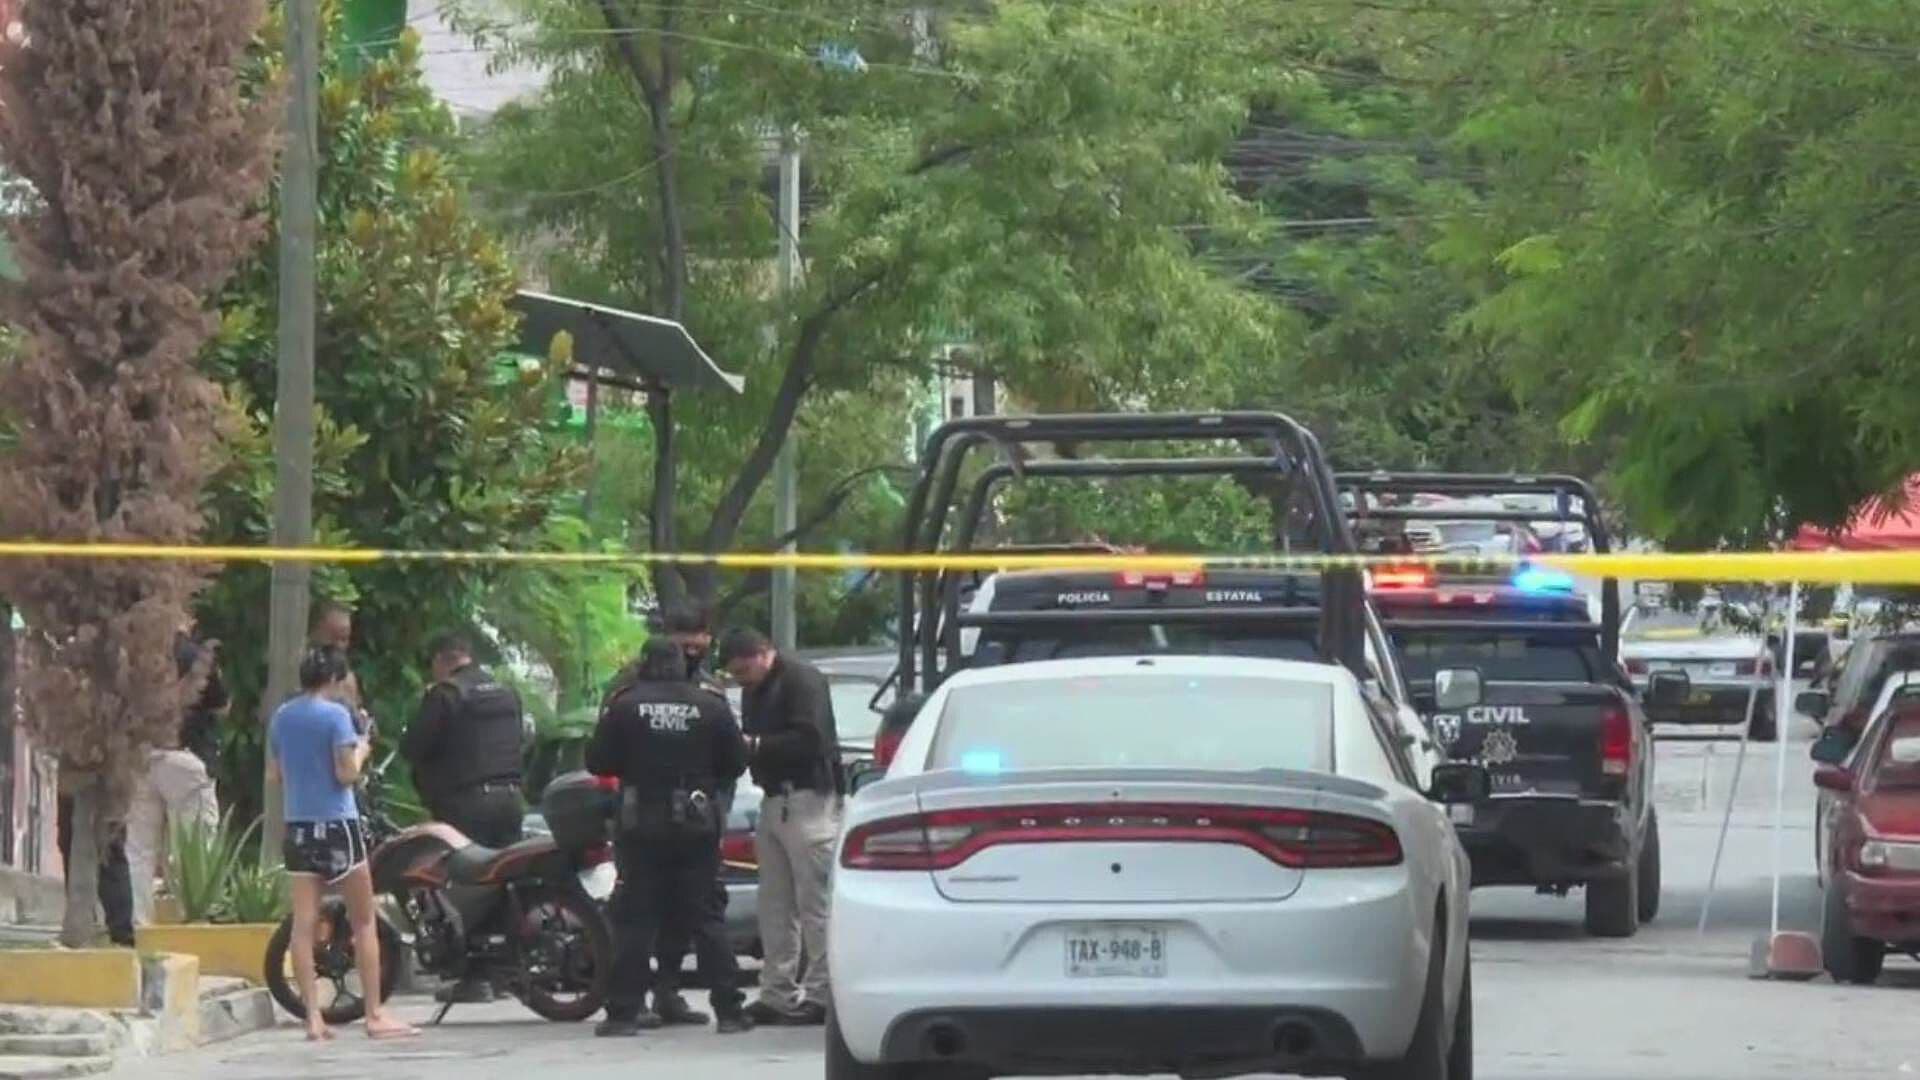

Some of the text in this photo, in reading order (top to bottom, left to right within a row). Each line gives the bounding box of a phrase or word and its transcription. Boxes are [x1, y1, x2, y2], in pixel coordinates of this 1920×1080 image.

[1206, 591, 1262, 602] ESTATAL
[639, 703, 701, 718] FUERZA
[1467, 706, 1530, 723] CIVIL
[650, 715, 689, 731] CIVIL
